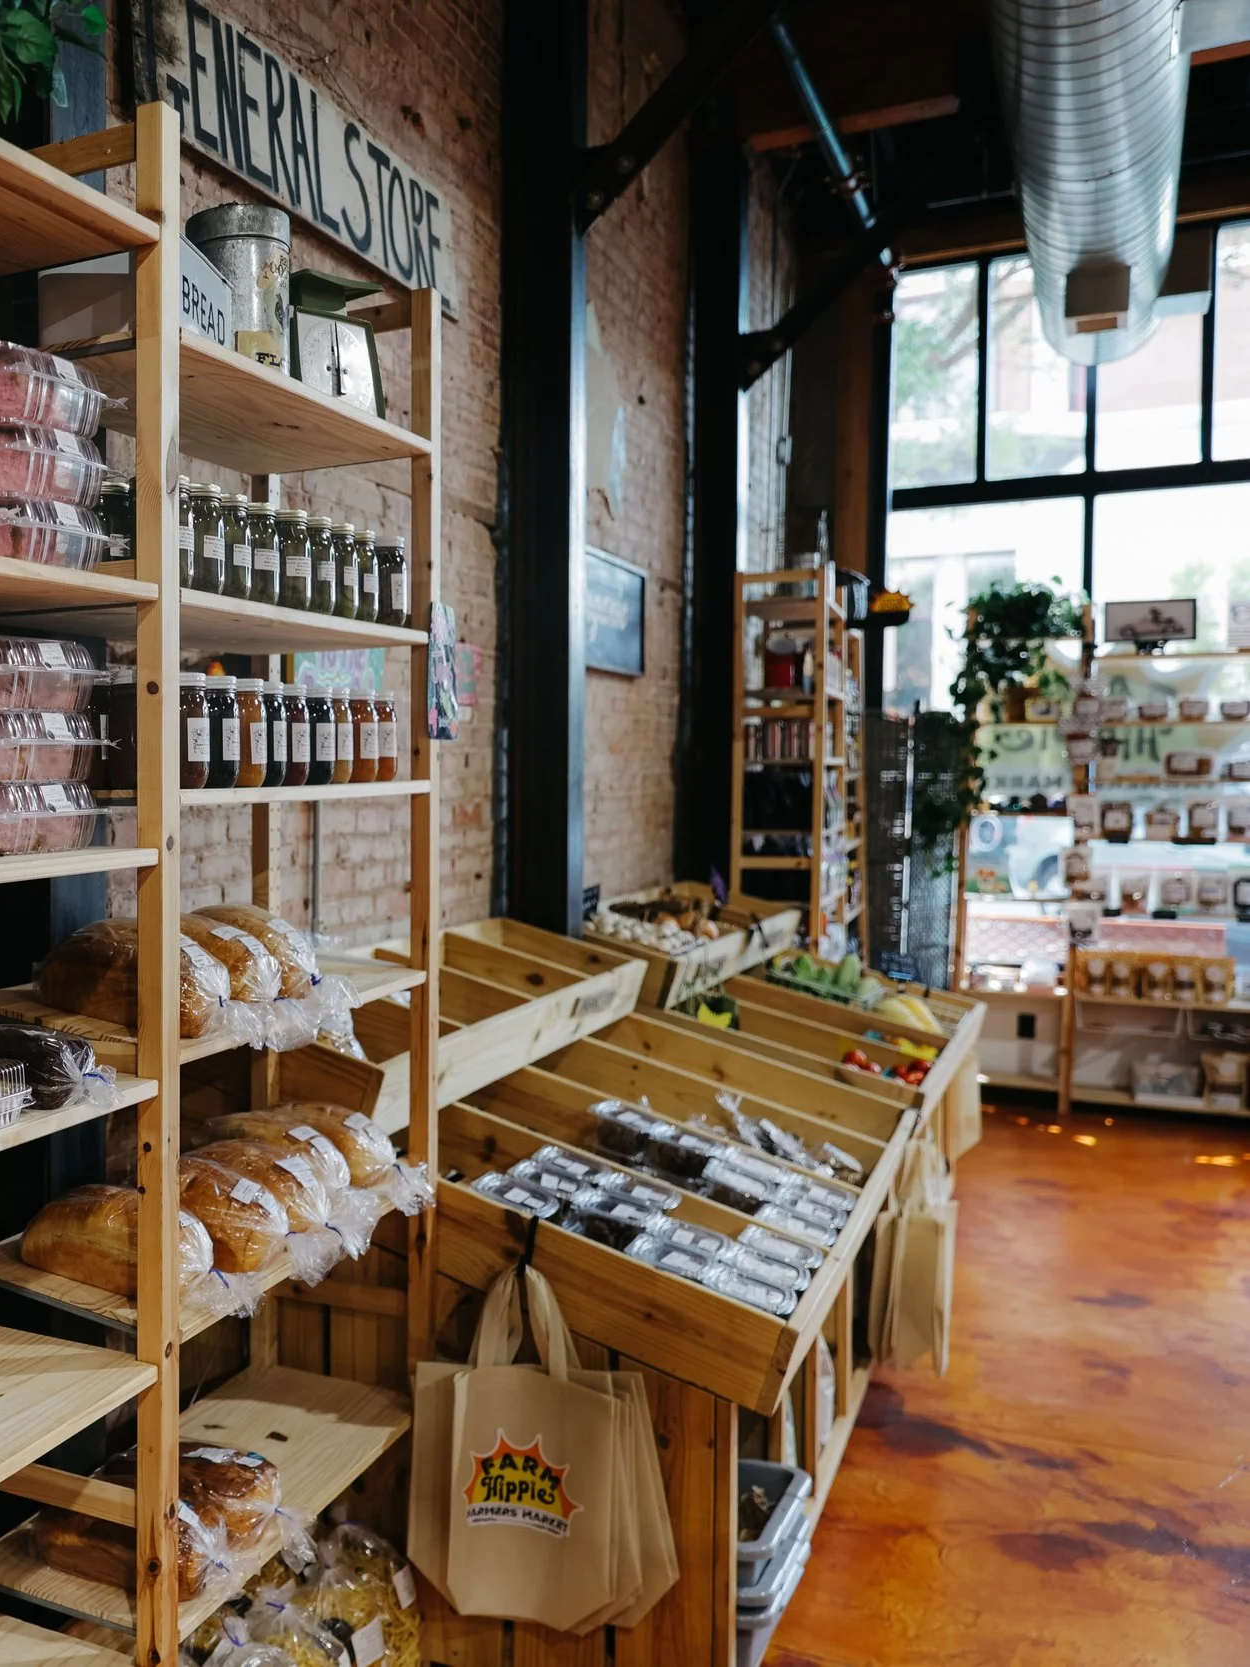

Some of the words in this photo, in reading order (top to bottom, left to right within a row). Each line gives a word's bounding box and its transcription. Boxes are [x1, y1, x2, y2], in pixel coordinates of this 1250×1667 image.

[182, 274, 226, 347] BREAD
[480, 1452, 561, 1491] FARM
[480, 1474, 556, 1505] Hippie
